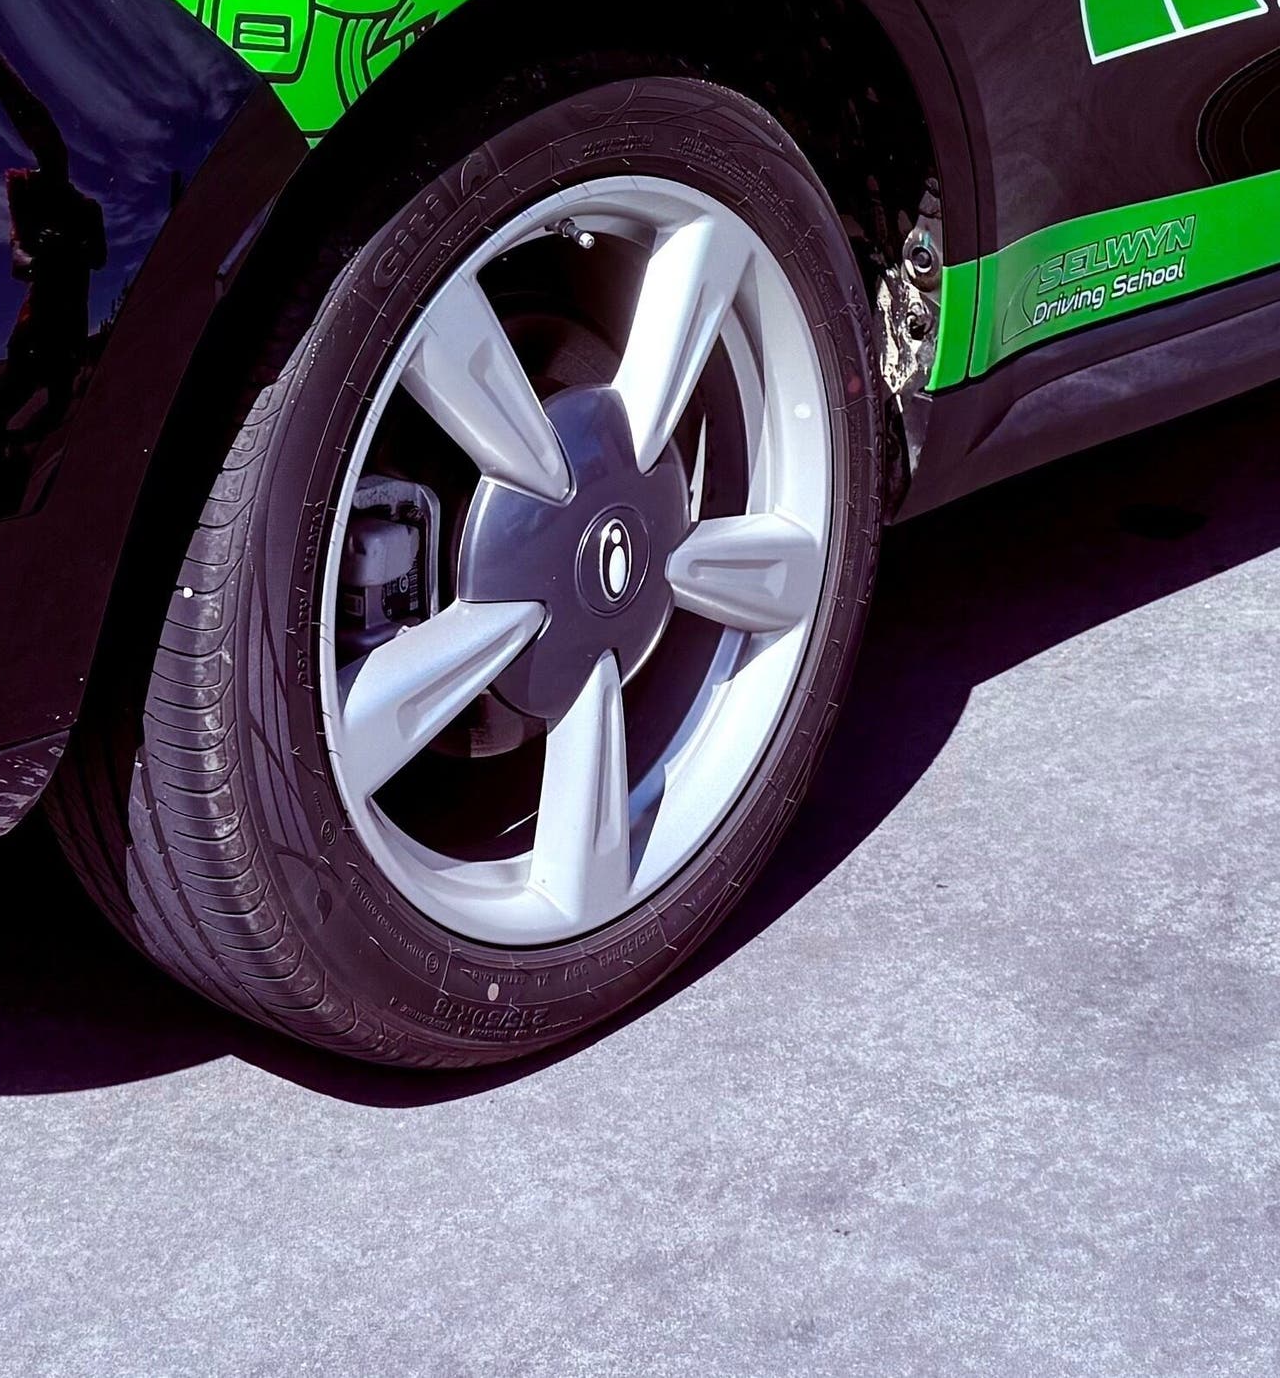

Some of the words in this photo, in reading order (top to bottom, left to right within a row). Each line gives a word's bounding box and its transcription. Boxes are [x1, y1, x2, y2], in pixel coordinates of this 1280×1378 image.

[1032, 285, 1105, 326] Driving
[1111, 256, 1185, 299] School
[1037, 215, 1196, 295] SELWYN
